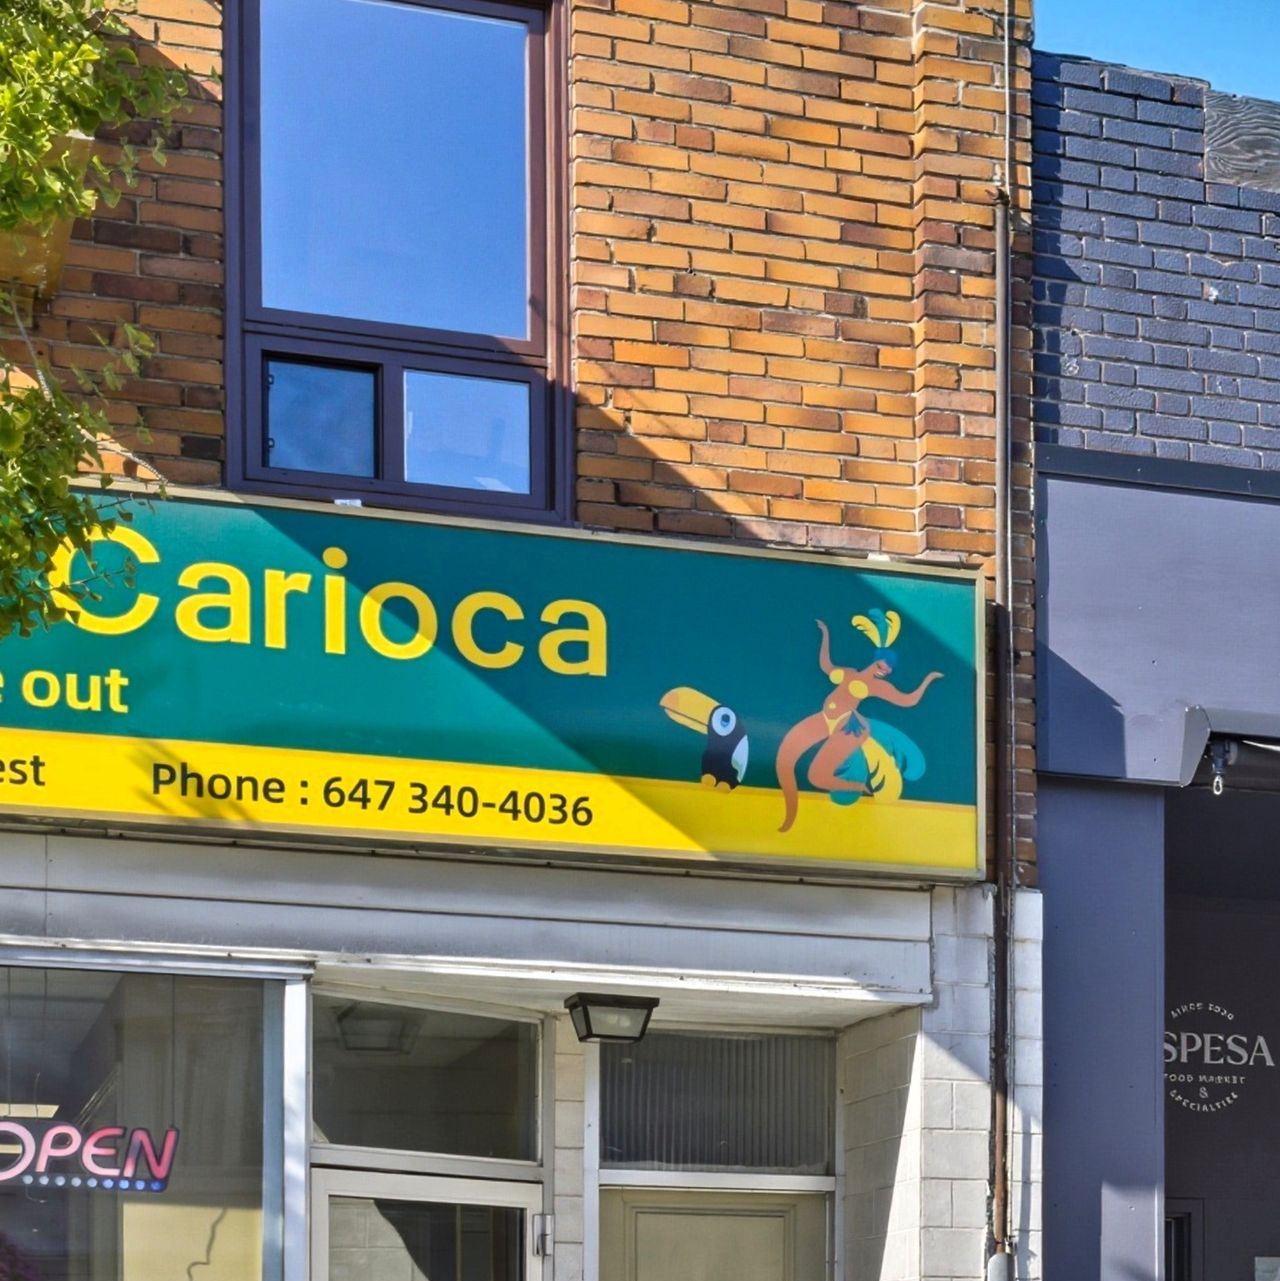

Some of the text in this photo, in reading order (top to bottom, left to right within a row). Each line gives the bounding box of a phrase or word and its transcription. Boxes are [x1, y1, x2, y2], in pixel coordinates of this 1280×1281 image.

[48, 522, 607, 677] Carioca
[22, 668, 129, 713] out
[0, 754, 46, 788] st
[152, 763, 286, 805] Phone
[322, 776, 396, 811] 647
[408, 782, 593, 827] 340-4036
[1163, 1031, 1275, 1066] SPESA
